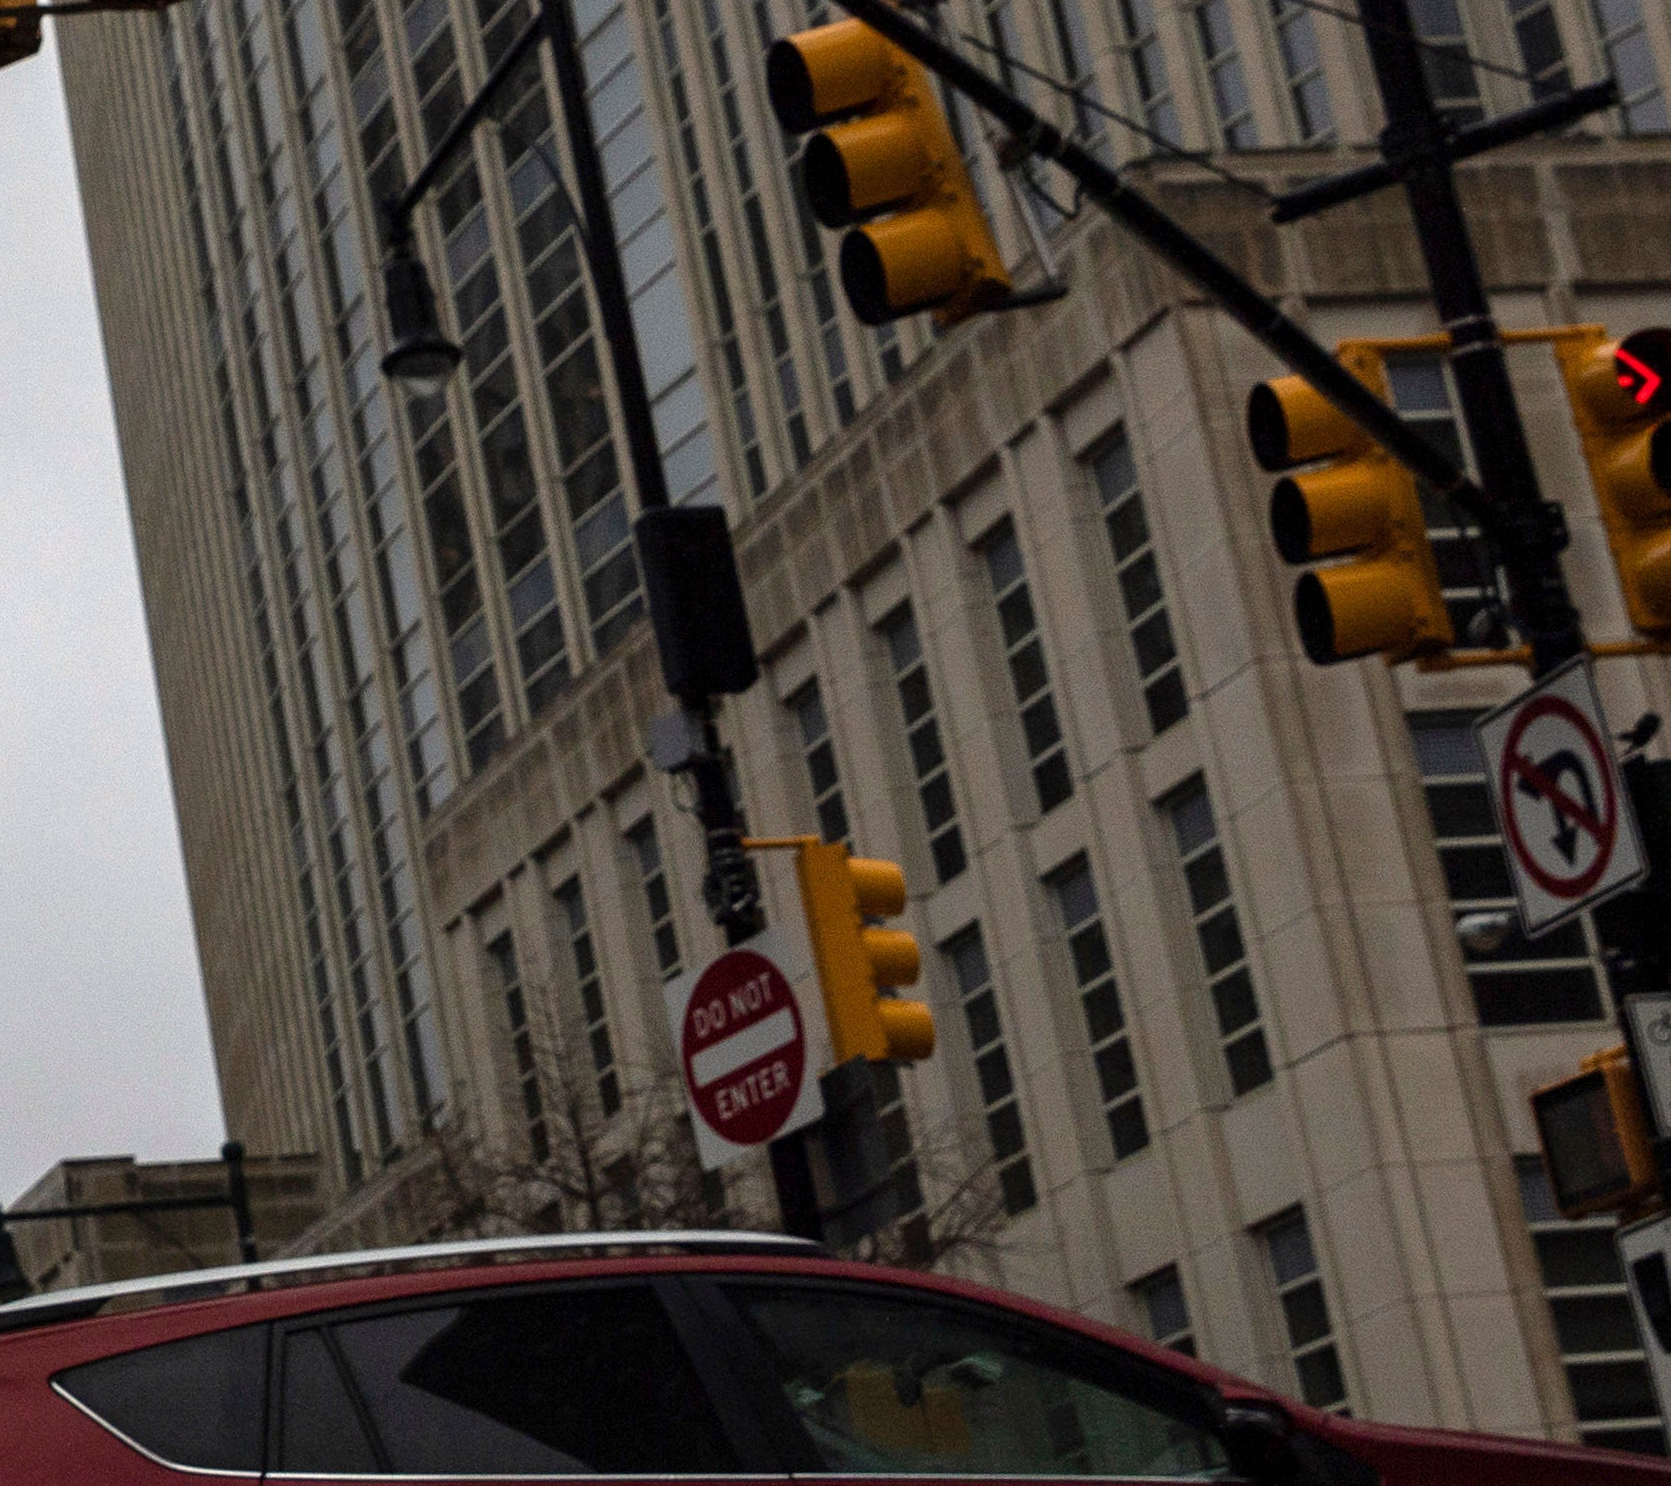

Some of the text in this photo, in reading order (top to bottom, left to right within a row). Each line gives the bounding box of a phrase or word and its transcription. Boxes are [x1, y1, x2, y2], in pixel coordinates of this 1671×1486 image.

[692, 971, 774, 1038] DO NOT
[715, 1061, 790, 1120] ENTER
